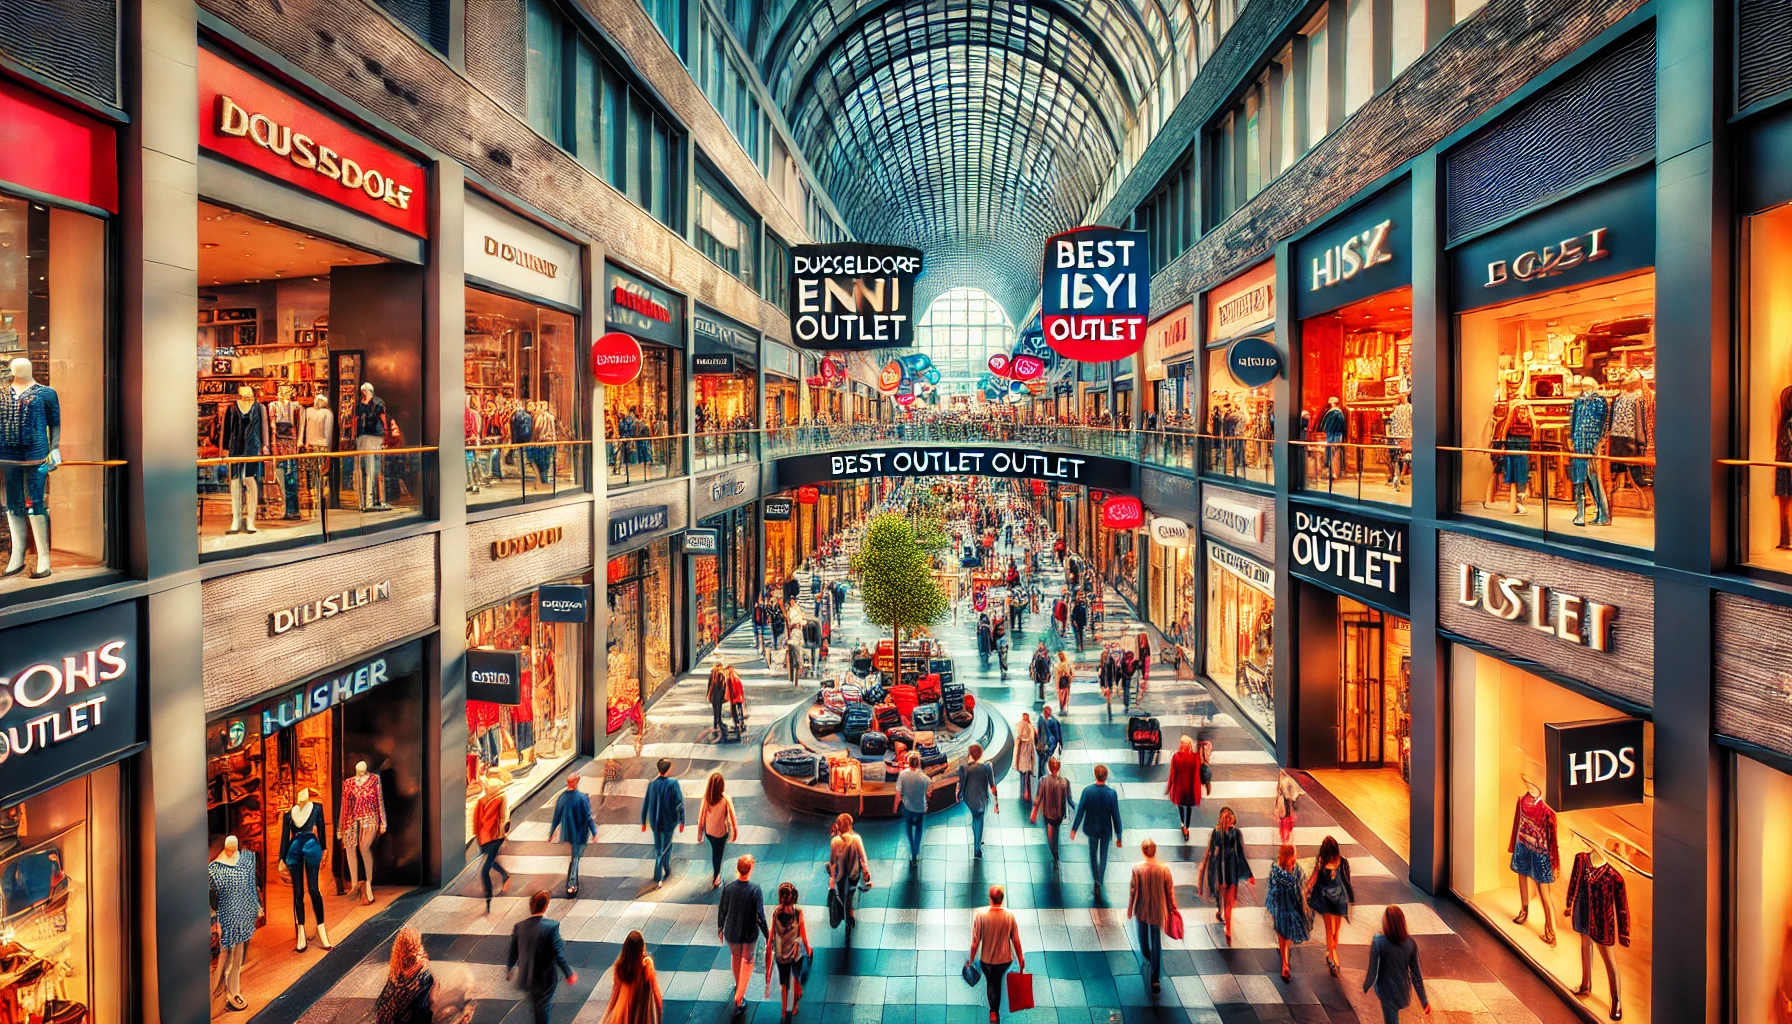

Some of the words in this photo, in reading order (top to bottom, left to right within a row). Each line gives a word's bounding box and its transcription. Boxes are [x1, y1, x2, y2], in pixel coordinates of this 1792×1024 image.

[1057, 240, 1136, 269] BEST
[796, 314, 907, 340] OUTLET
[1049, 316, 1142, 341] OUTLET
[831, 453, 886, 475] BEST
[893, 452, 985, 473] OUTLET
[992, 452, 1086, 479] OUTLET
[1292, 531, 1402, 593] OUTLET
[1567, 746, 1637, 786] HDS
